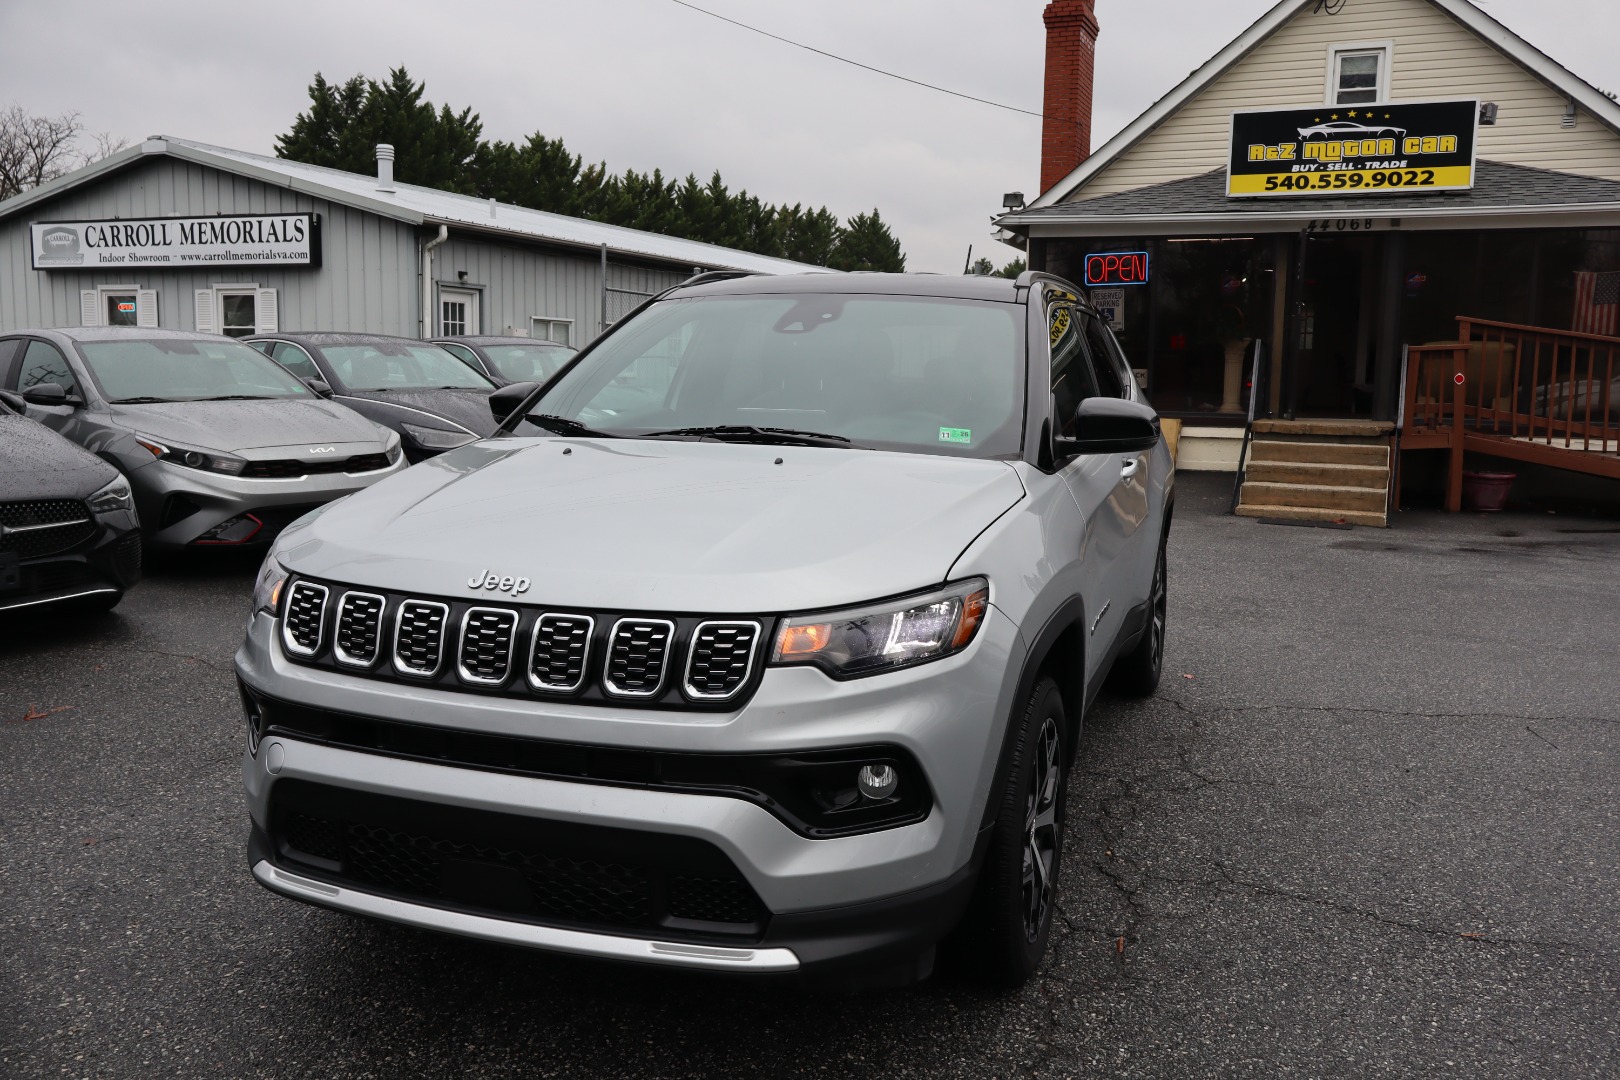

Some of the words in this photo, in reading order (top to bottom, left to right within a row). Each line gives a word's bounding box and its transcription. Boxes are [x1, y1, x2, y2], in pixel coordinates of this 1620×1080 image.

[1248, 143, 1297, 162] R&Z
[1291, 164, 1318, 173] BUY
[1327, 162, 1355, 171] SELL
[1364, 160, 1408, 169] TRADE
[1265, 170, 1434, 190] 540.559.9022
[84, 224, 173, 248] CARROLL
[179, 218, 305, 245] MEMORIALS
[98, 252, 126, 263] Indoor
[128, 252, 171, 262] Showroom
[180, 249, 308, 261] www.carrollmemorialsva.com
[1088, 255, 1145, 282] OPEN
[1093, 292, 1122, 300] RESERVED
[1095, 300, 1120, 308] PARKING
[467, 569, 531, 597] Jeep
